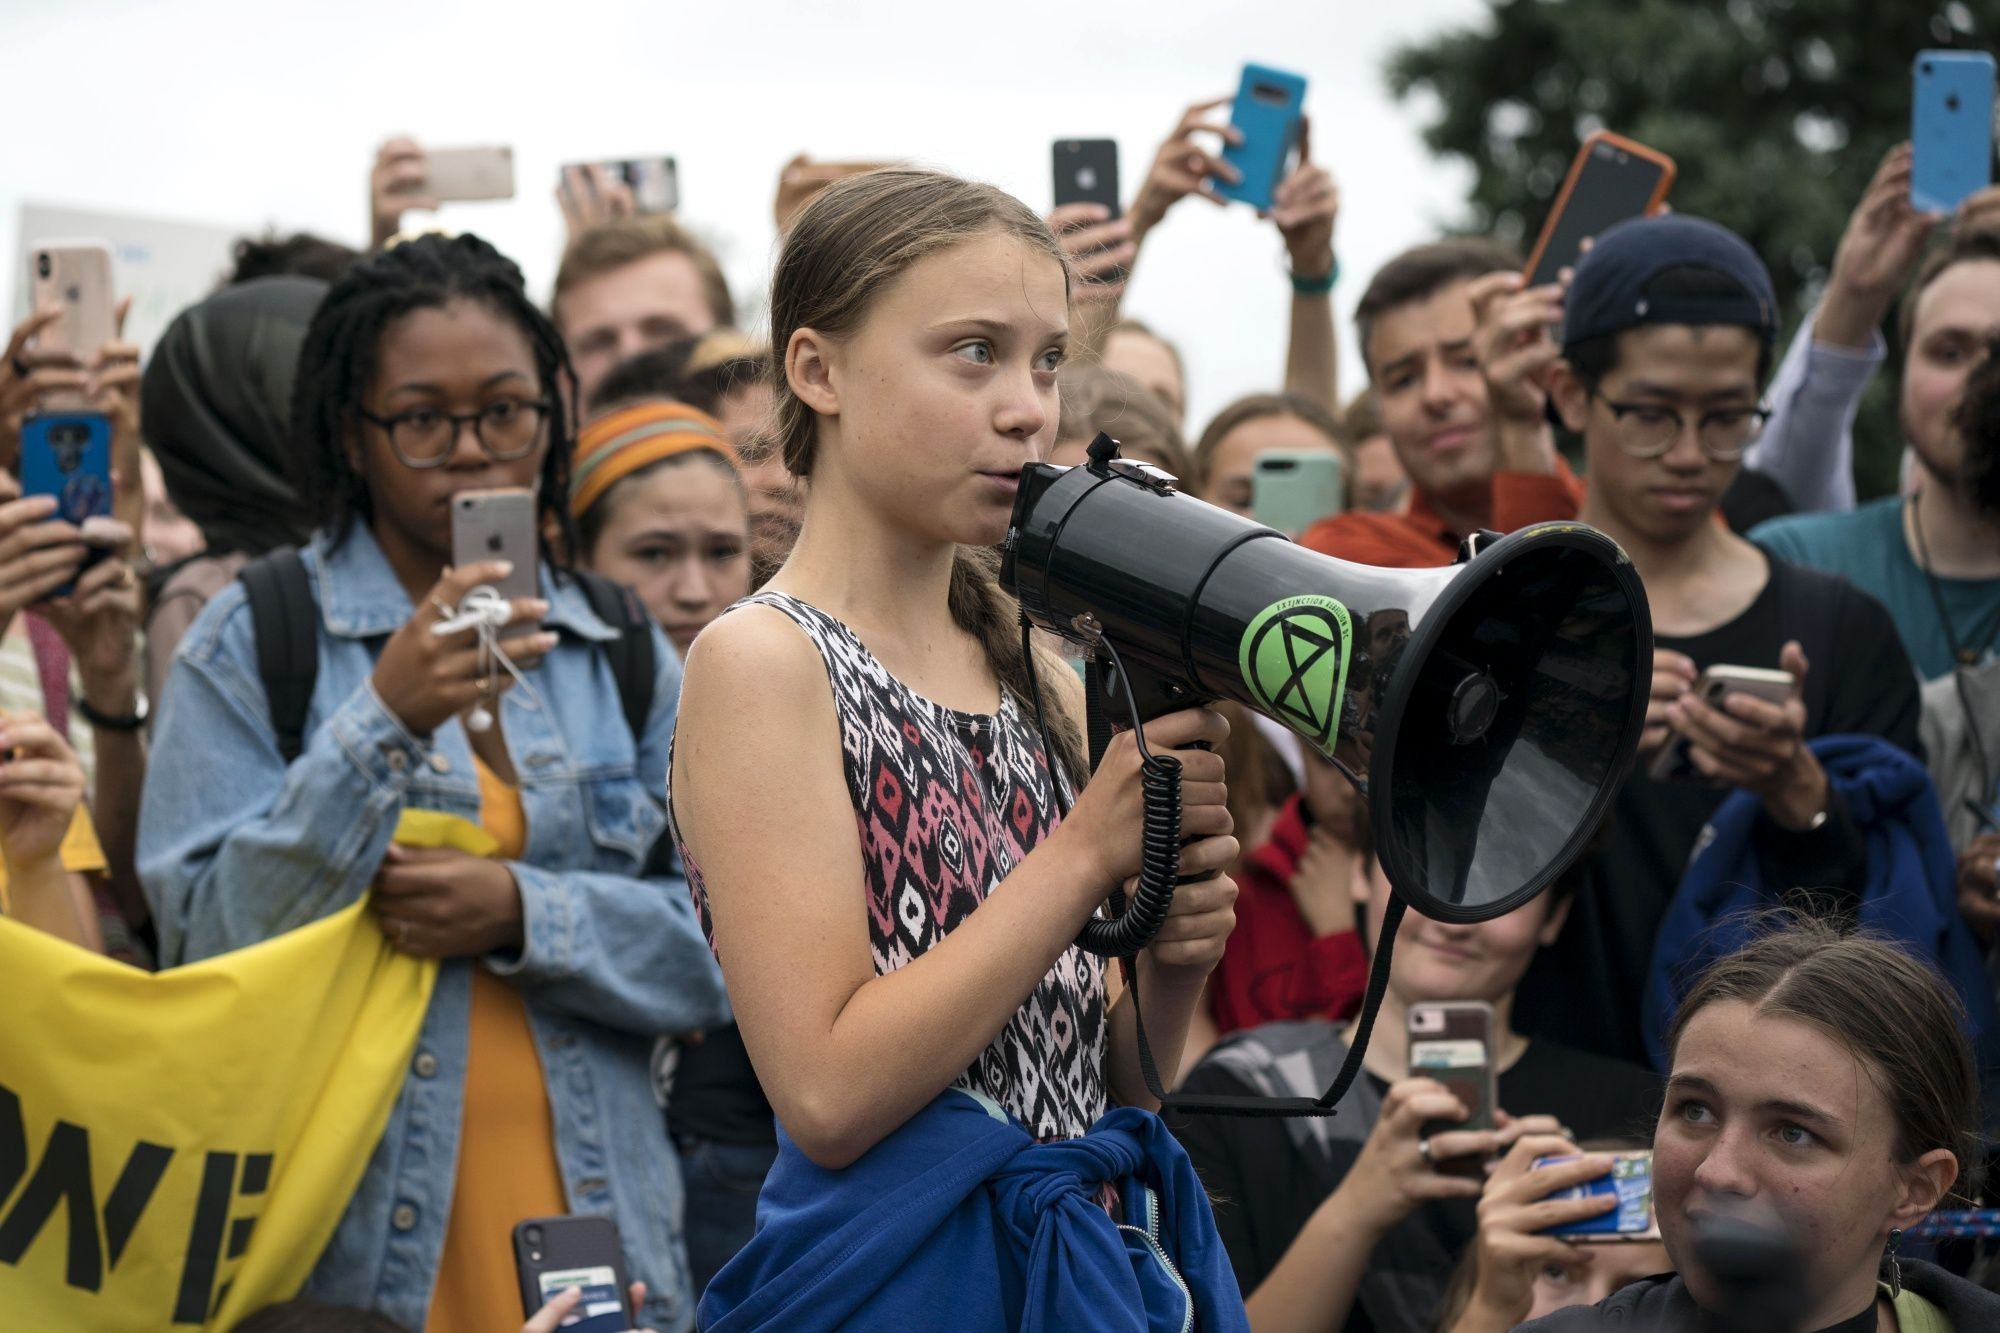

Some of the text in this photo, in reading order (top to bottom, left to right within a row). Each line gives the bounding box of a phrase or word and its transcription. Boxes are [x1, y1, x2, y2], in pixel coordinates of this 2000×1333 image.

[1276, 597, 1349, 640] EXTINCTION REBELLION DC
